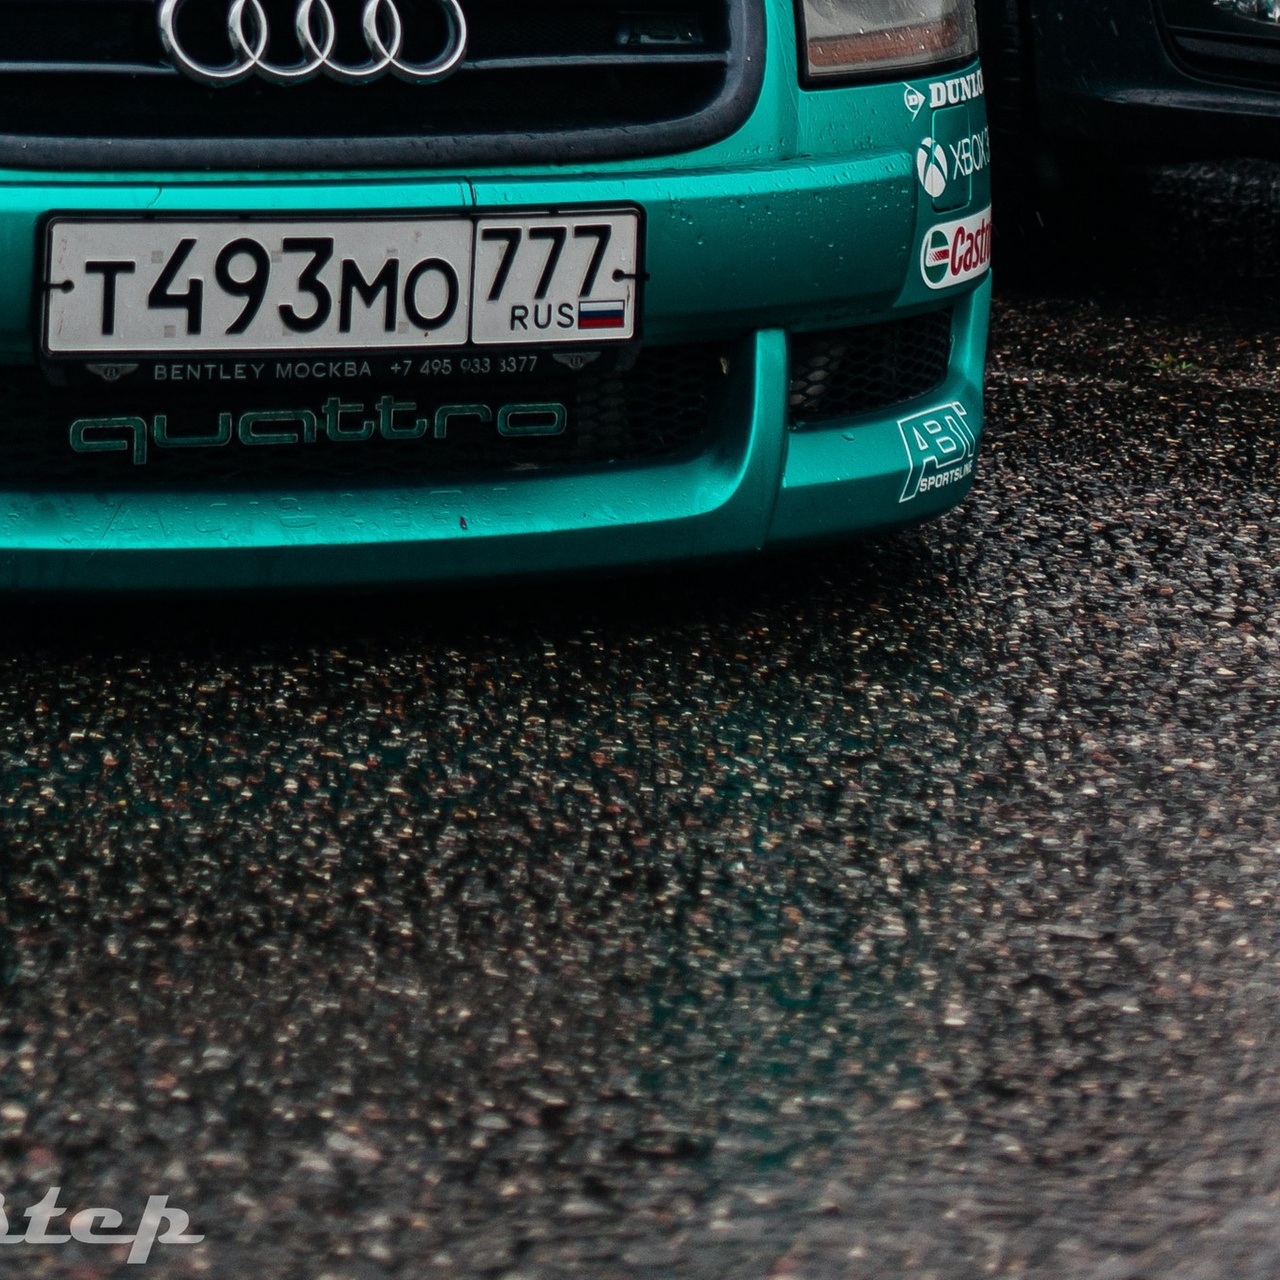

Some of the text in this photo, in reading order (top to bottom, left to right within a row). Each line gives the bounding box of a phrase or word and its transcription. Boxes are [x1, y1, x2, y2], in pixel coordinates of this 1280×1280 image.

[928, 66, 984, 109] DUNLO
[949, 130, 988, 180] XBOX
[950, 218, 991, 276] Castro
[84, 224, 612, 337] Т493МО 777
[510, 302, 575, 331] RUS
[154, 362, 266, 381] BENTLEY
[275, 360, 373, 379] МОСКВА
[390, 359, 413, 377] +7
[419, 358, 453, 376] 495
[69, 395, 568, 465] quattro
[897, 401, 976, 503] ABT
[919, 459, 974, 492] SPORTSLINE
